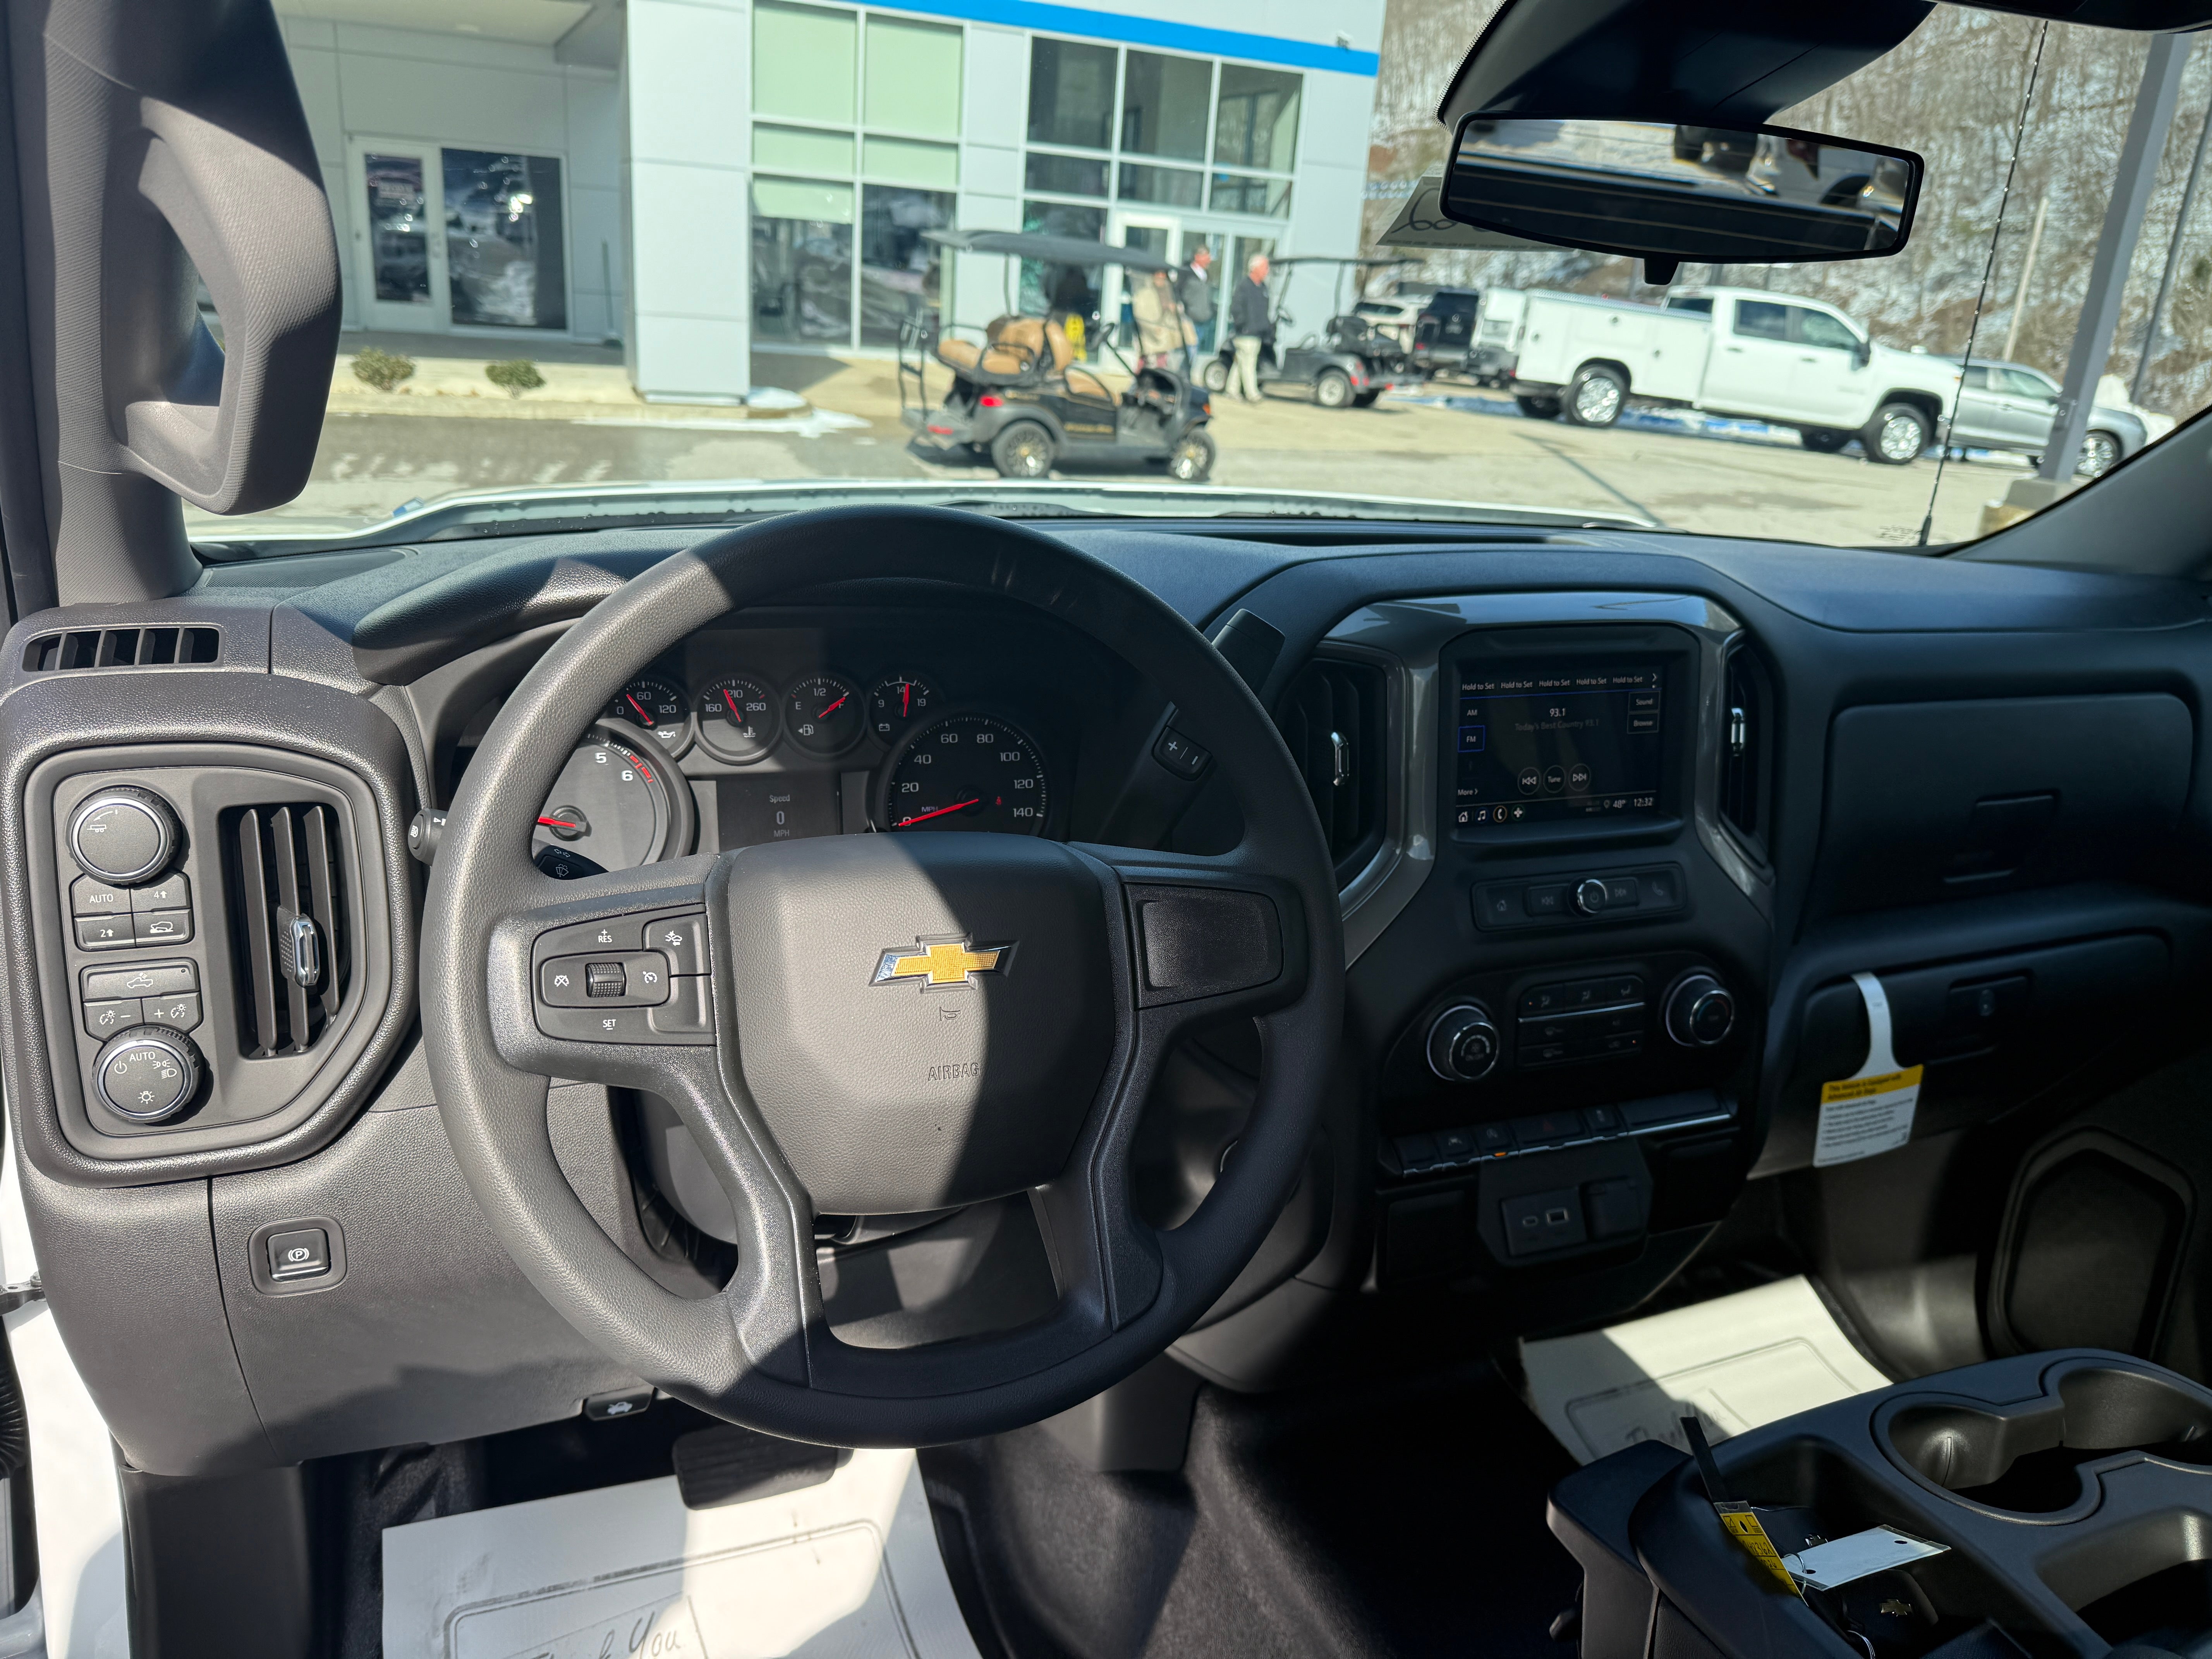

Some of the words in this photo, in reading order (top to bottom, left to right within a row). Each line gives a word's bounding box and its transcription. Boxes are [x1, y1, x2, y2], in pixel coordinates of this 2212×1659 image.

[637, 692, 651, 700] 60
[727, 690, 743, 698] 210
[814, 688, 826, 696] 1/2
[746, 702, 766, 711] 260
[795, 702, 801, 710] E
[878, 699, 884, 708] 9
[917, 698, 926, 706] 19
[617, 706, 624, 714] 0
[658, 705, 677, 714] 120
[705, 703, 722, 712] 160
[1549, 708, 1566, 717] 93.1
[941, 733, 958, 744] 60
[976, 733, 994, 744] 80
[595, 752, 607, 764] 5
[914, 754, 931, 764] 40
[1000, 752, 1020, 762] 100
[621, 770, 633, 781] 6
[901, 782, 919, 793] 20
[1013, 779, 1034, 789] 120
[769, 794, 790, 804] Speed
[1634, 797, 1654, 807] 12:32
[1013, 807, 1033, 817] 140
[776, 811, 785, 825] 0
[89, 893, 114, 904] AUTO
[100, 929, 106, 938] 2
[603, 1019, 616, 1028] SET
[129, 1051, 155, 1062] AUTO
[928, 1063, 980, 1081] AIRBAG
